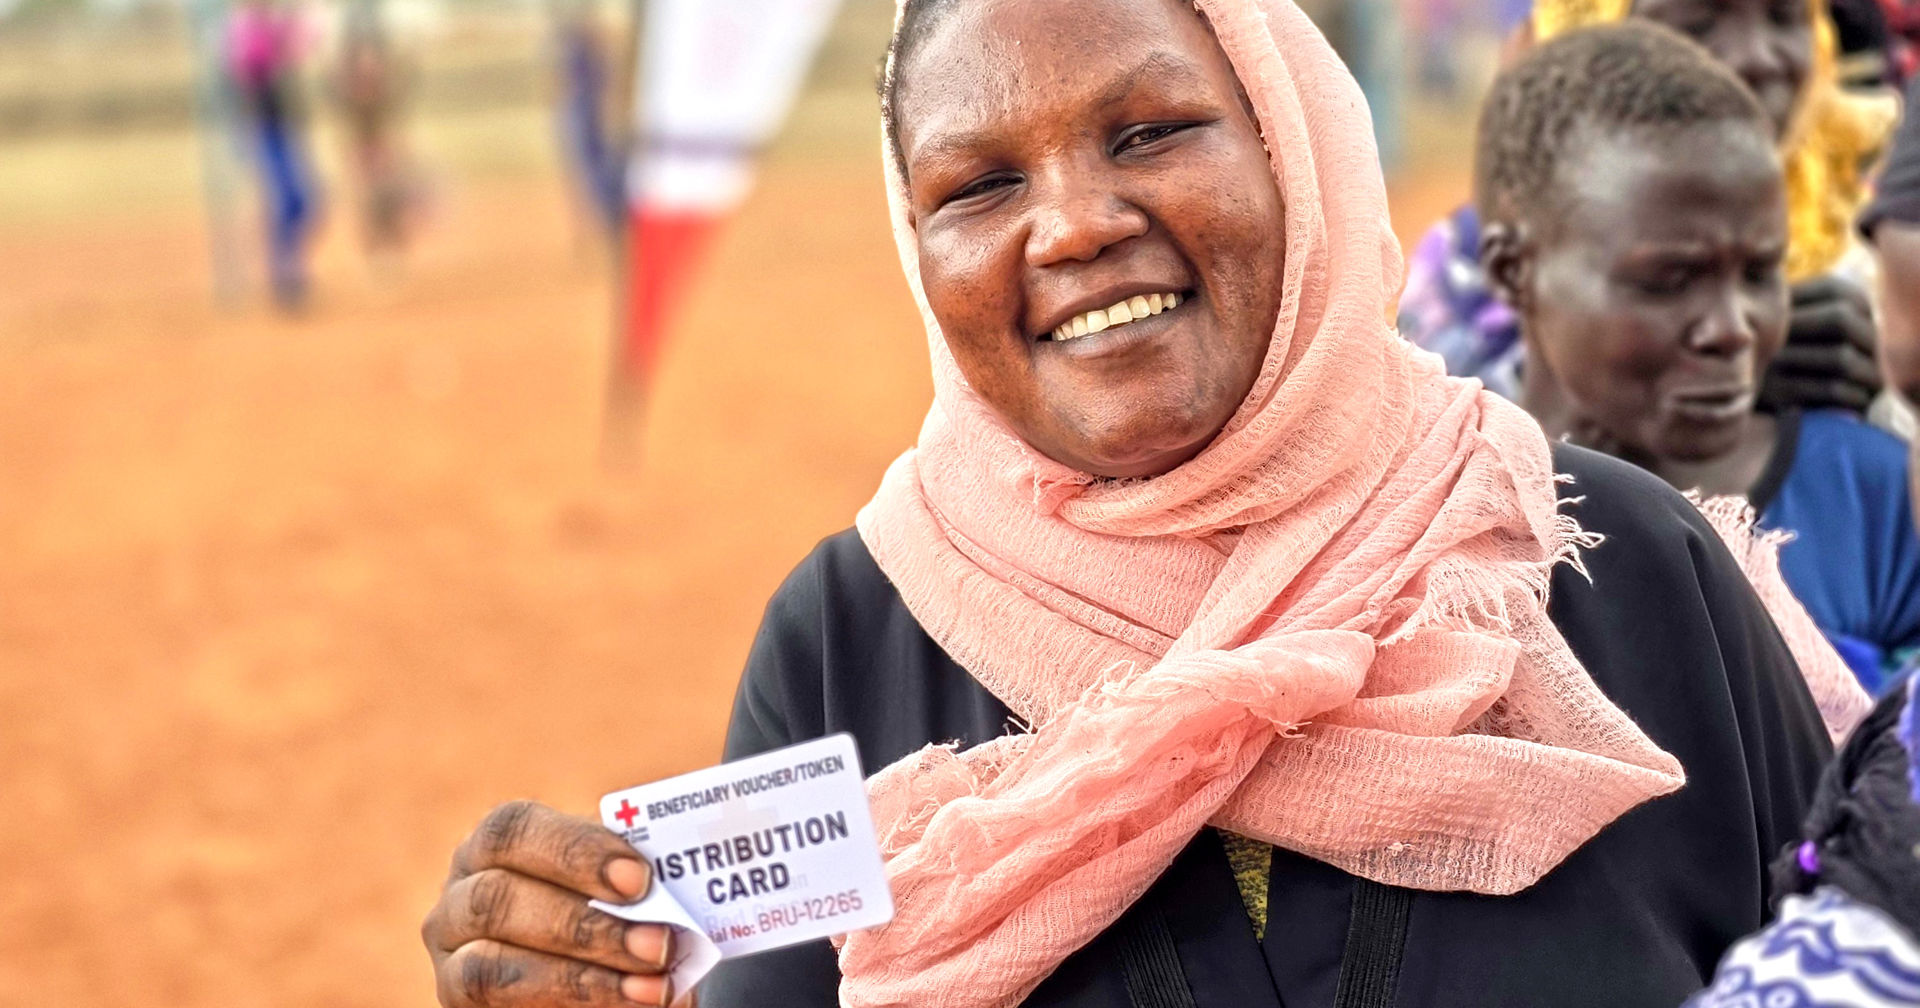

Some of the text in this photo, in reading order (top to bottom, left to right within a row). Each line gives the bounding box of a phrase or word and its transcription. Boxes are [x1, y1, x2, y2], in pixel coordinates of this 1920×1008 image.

[647, 755, 844, 820] BENEFICIARY VOUCHER/TOKEN
[655, 810, 849, 883] ISTRIBUTION
[706, 862, 790, 904] CARD
[709, 927, 727, 943] ial
[731, 923, 756, 940] No:
[758, 889, 863, 933] BRU-12265
